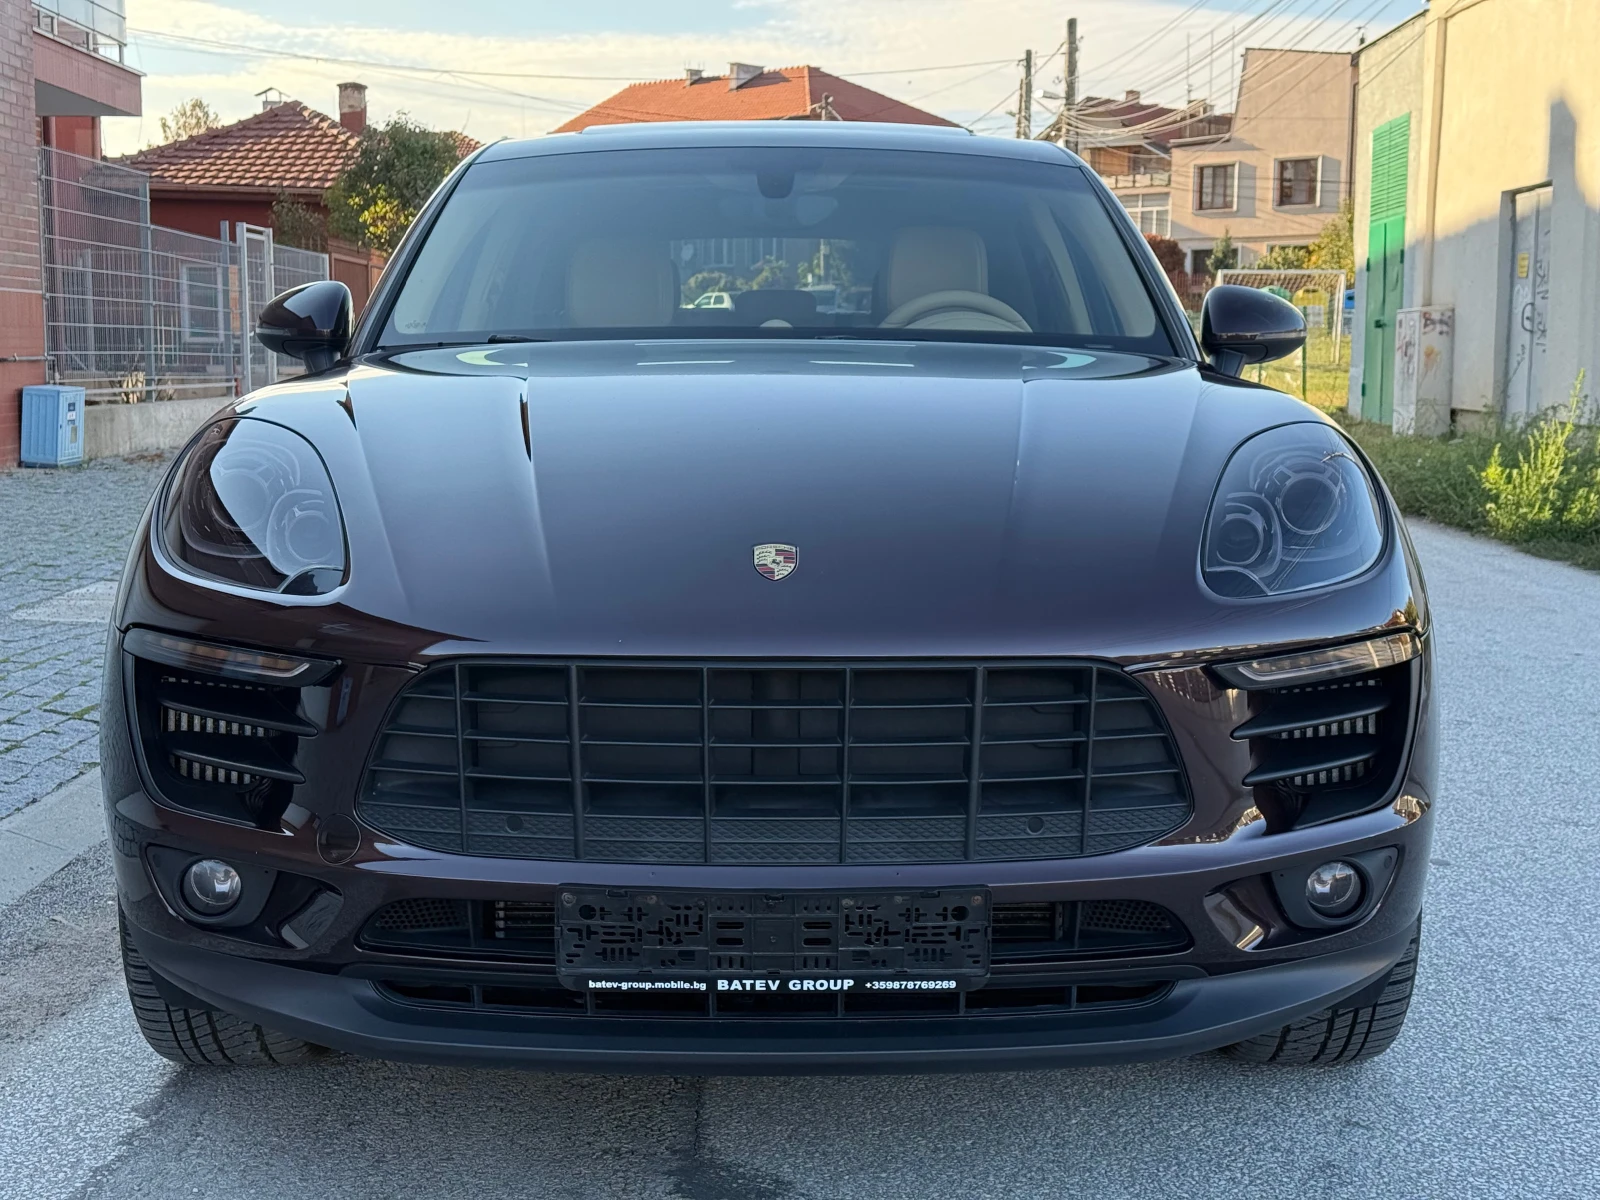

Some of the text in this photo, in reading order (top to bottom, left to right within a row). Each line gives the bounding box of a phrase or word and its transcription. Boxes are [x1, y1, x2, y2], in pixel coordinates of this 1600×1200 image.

[588, 979, 957, 991] batev-group.mobile.bg BATEV GROUP +359878769269
